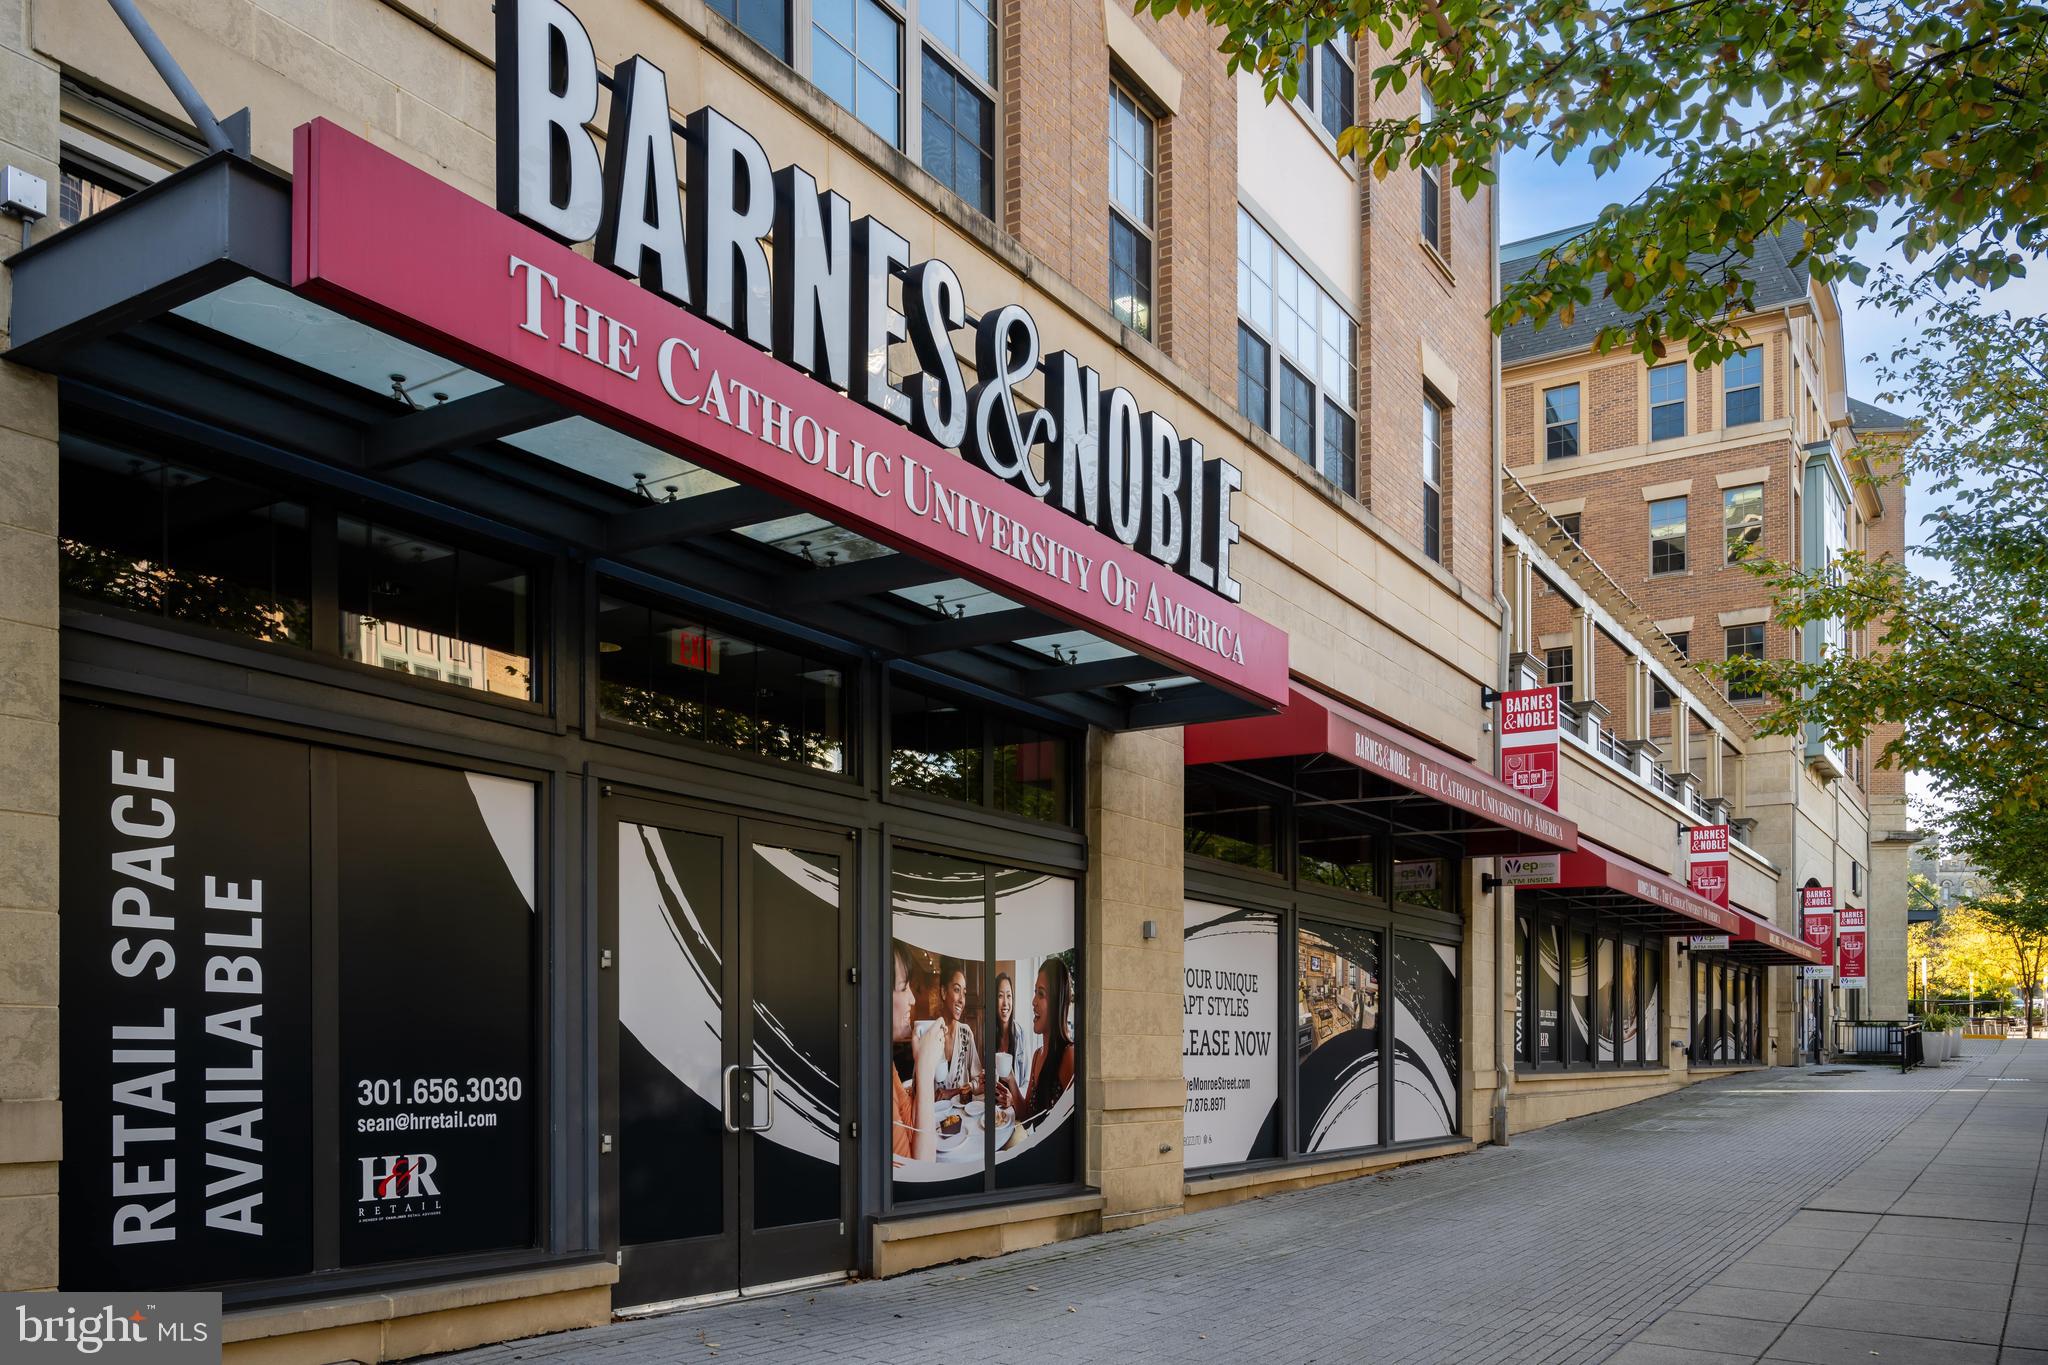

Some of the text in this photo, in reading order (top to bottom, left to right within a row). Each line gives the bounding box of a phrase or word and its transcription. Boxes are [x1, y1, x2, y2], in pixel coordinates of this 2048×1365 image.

[497, 0, 1242, 603] BARNES&NOBLE
[509, 254, 1245, 665] THE CATHOLIC UNIVERSITY OF AMERICA
[680, 631, 714, 672] EXIT
[1506, 693, 1553, 713] BARNES
[1504, 710, 1555, 730] &NOBLE
[1355, 732, 1411, 779] BARNES&NOBLE
[1420, 762, 1439, 791] THE
[1440, 772, 1480, 808] CATHOLIC
[1481, 789, 1523, 825] UNIVERSITY
[1523, 808, 1534, 829] OF
[1535, 814, 1563, 840] AMERICA
[1692, 840, 1726, 851] &NOBLE
[1693, 829, 1725, 841] BARNES
[1522, 862, 1538, 873] ep
[1806, 890, 1830, 898] BARNES
[1184, 968, 1258, 997] OUR UNIQUE
[111, 749, 176, 1246] RETAIL SPACE
[1207, 996, 1249, 1018] STYLES
[1515, 955, 1523, 1053] AVAILABLE
[204, 875, 263, 1236] AVAILABLE
[1234, 1030, 1271, 1056] NOW
[357, 1077, 522, 1106] 301.656.3030
[1184, 1076, 1251, 1091] reMonroeStreet.com
[357, 1109, 498, 1133] sean@hrretail.com
[358, 1201, 441, 1217] RETAIL
